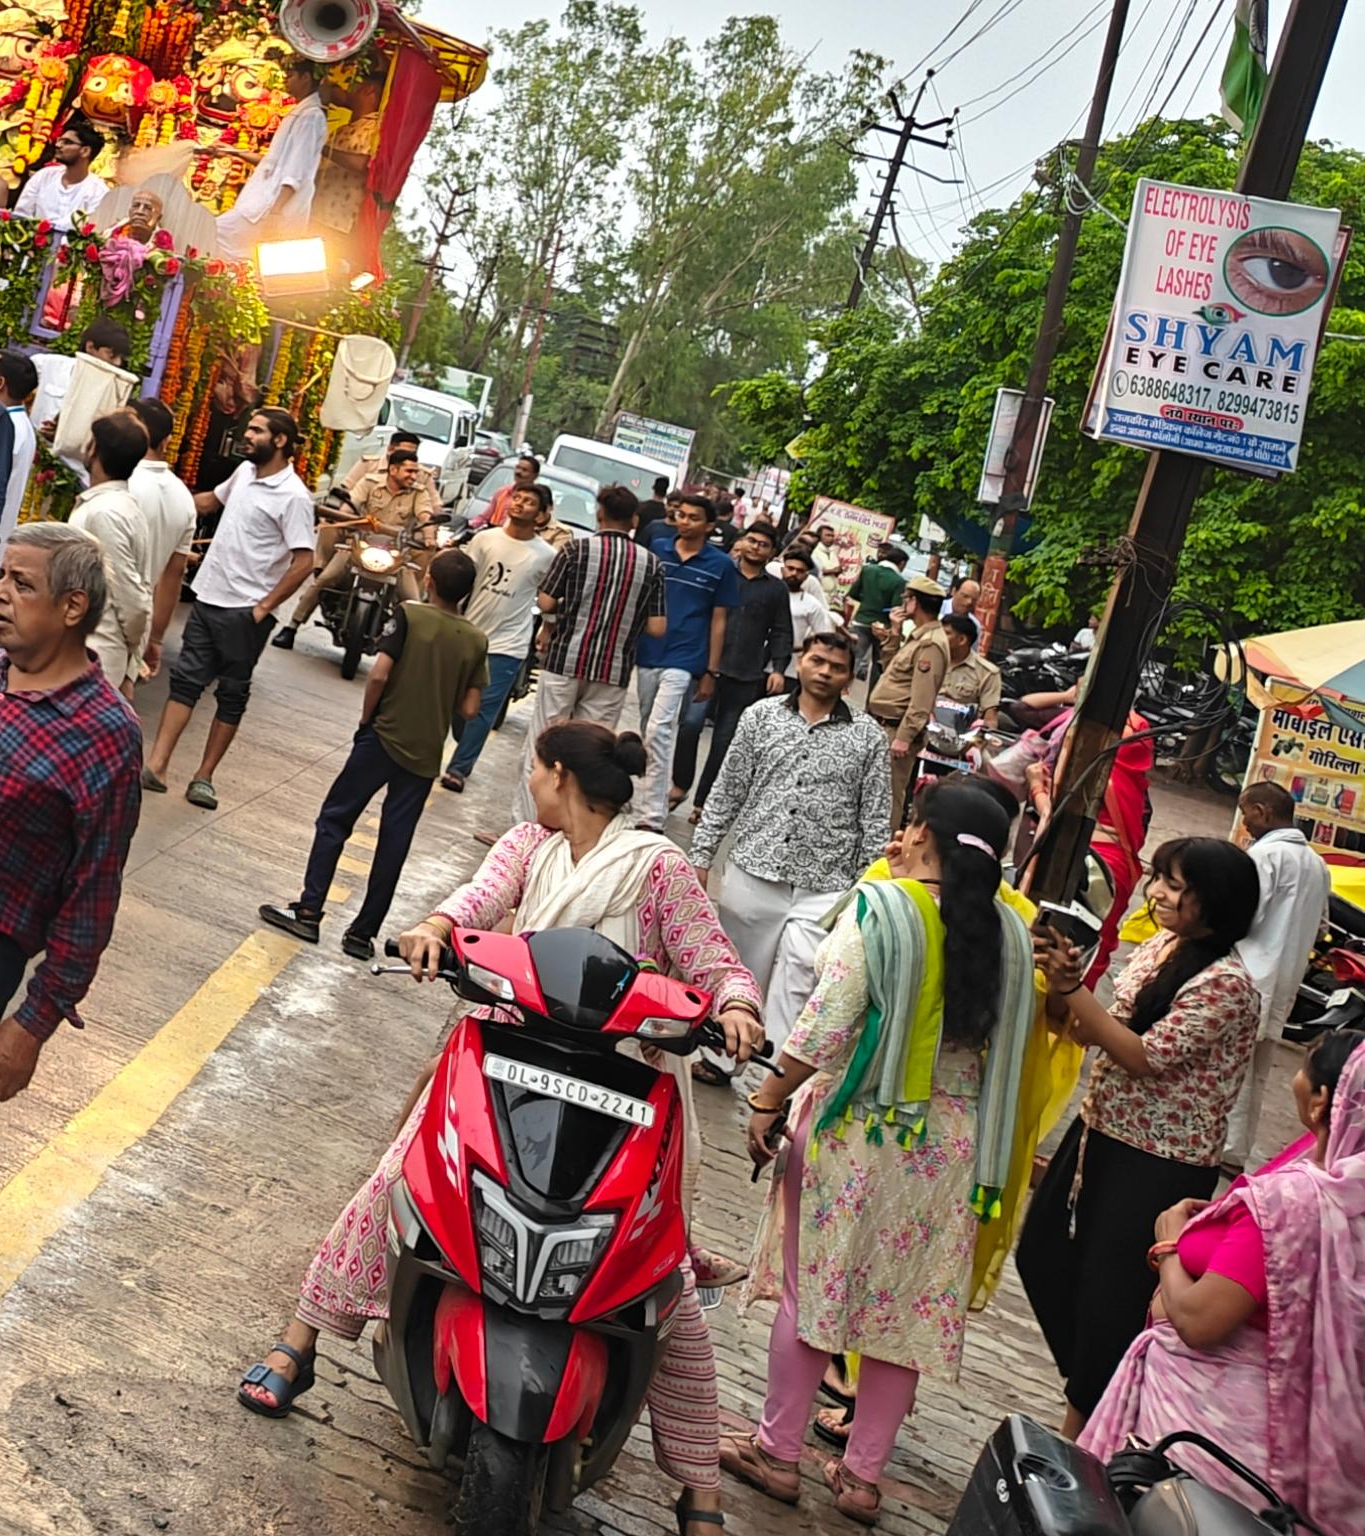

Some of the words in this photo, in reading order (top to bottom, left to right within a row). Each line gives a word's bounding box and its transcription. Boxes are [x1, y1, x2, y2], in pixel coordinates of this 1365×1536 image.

[1144, 187, 1251, 231] ELECTROLYSIS
[1165, 229, 1185, 257] OF
[1188, 232, 1218, 263] EYE
[1156, 265, 1213, 301] LASHES
[1125, 313, 1307, 372] SHYAM
[1125, 347, 1188, 374] EYE
[1203, 362, 1297, 394] CARE
[1130, 374, 1213, 412] 6388648317,
[1217, 390, 1300, 425] 8299473815
[600, 1092, 647, 1123] 2241
